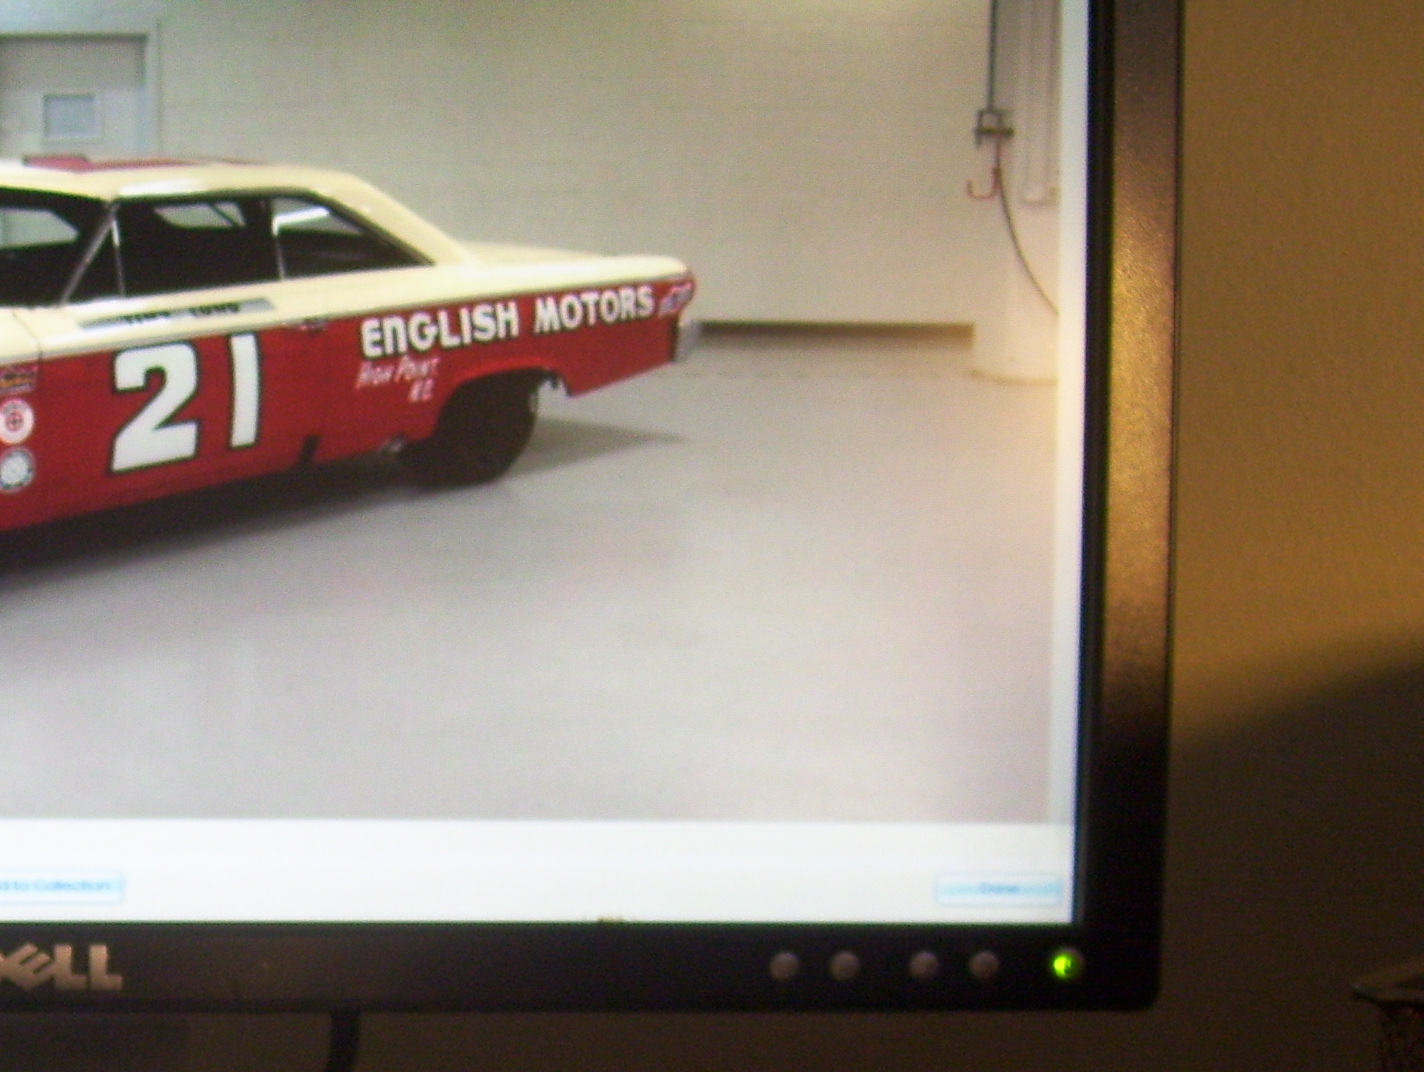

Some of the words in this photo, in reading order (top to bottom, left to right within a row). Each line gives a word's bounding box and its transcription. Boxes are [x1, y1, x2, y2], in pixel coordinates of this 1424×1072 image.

[360, 301, 520, 359] ENGLISH
[534, 284, 656, 334] MOTORS
[110, 328, 263, 475] 21
